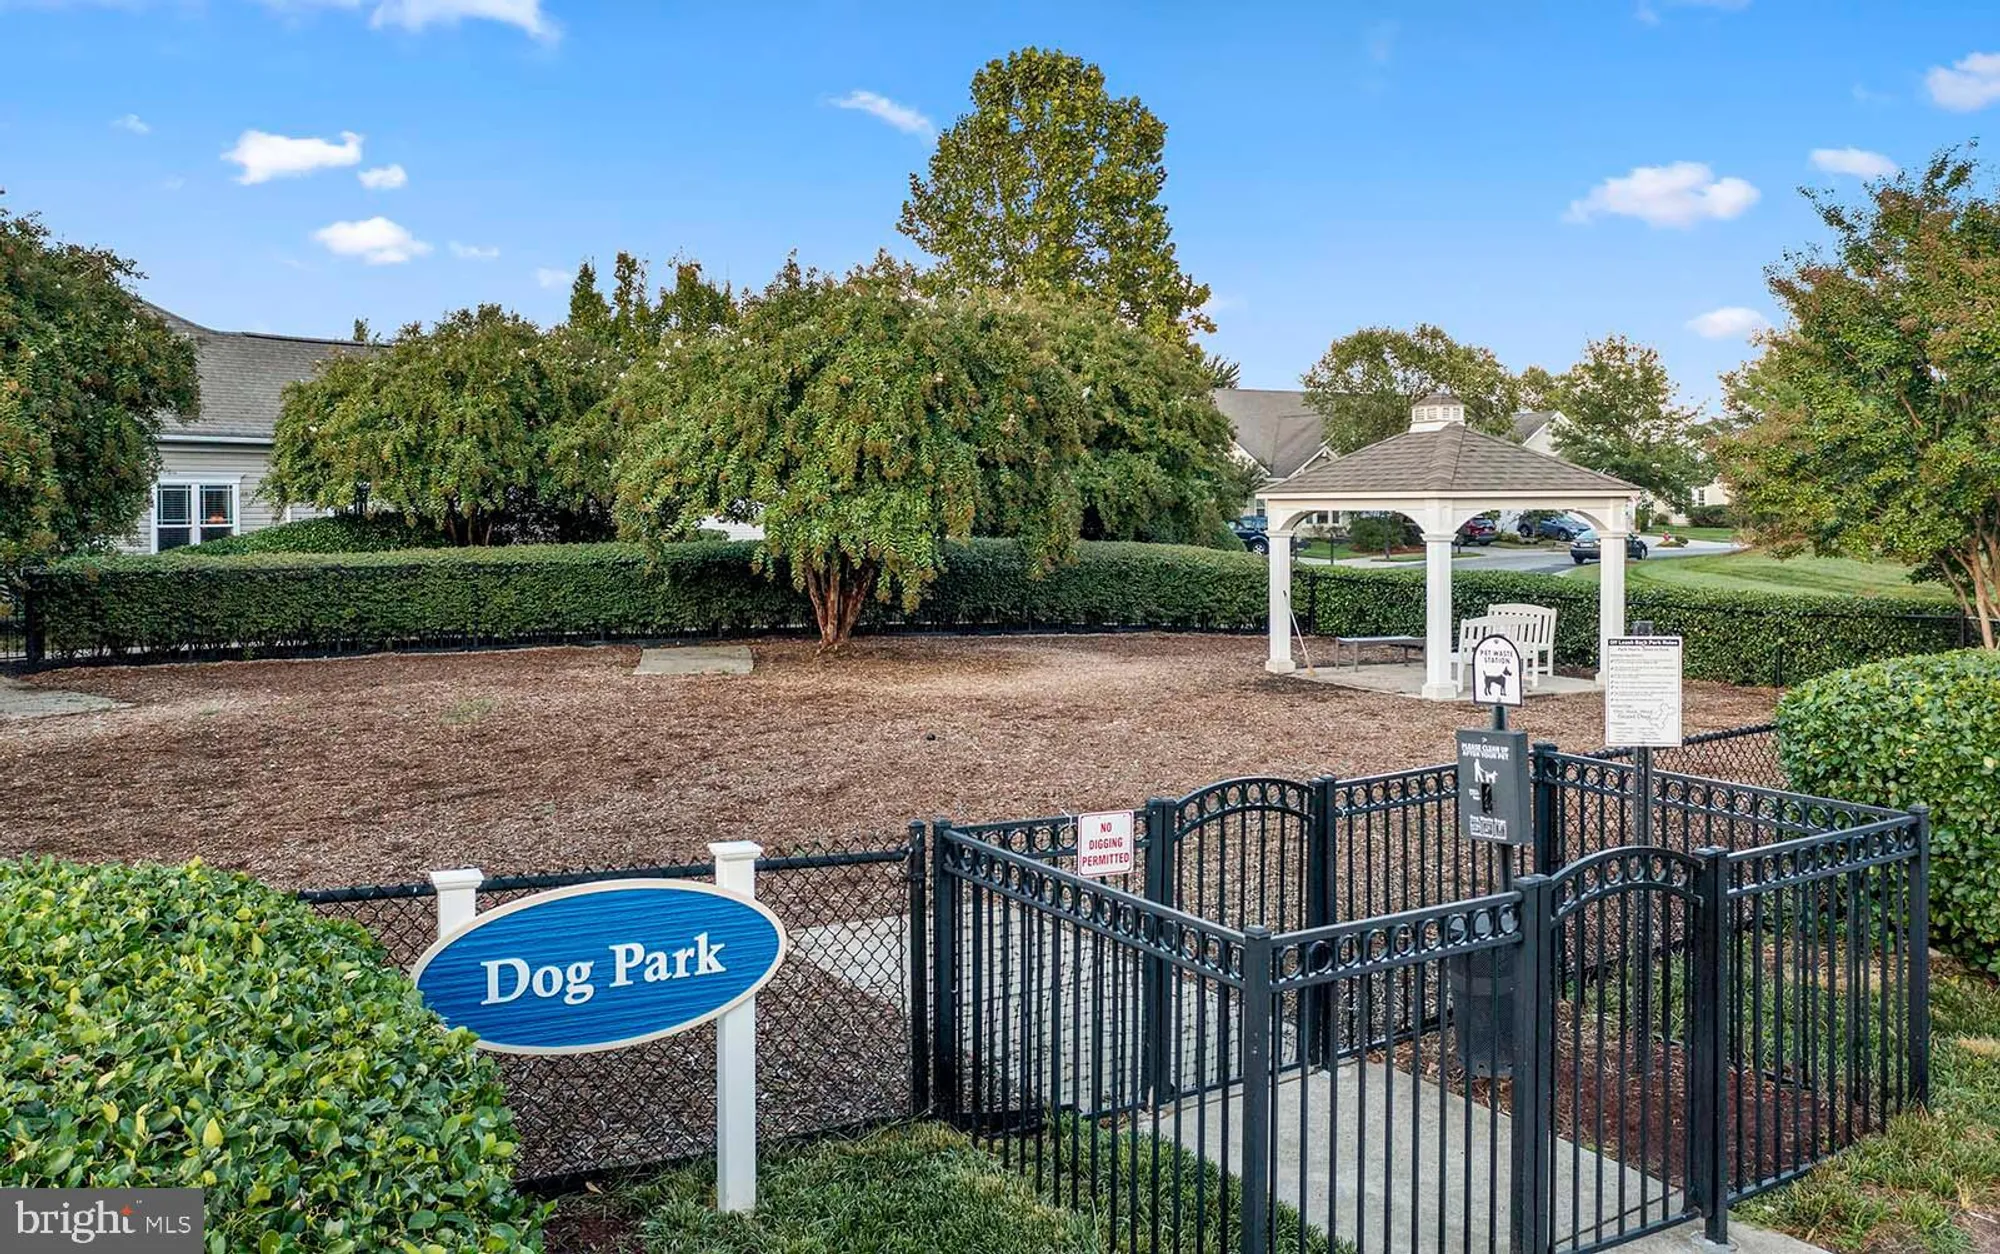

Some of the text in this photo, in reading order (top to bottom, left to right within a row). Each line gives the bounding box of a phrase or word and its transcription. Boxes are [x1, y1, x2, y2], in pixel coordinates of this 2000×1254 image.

[1484, 656, 1511, 664] STATION
[1461, 743, 1481, 751] PLEASE
[1482, 744, 1500, 753] CLEAN
[1462, 750, 1509, 760] AFTER YOUR PET
[1100, 822, 1112, 833] NO
[1089, 837, 1123, 850] DIGGING
[1082, 852, 1130, 867] PERMITTED
[480, 931, 727, 1006] Dog Park
